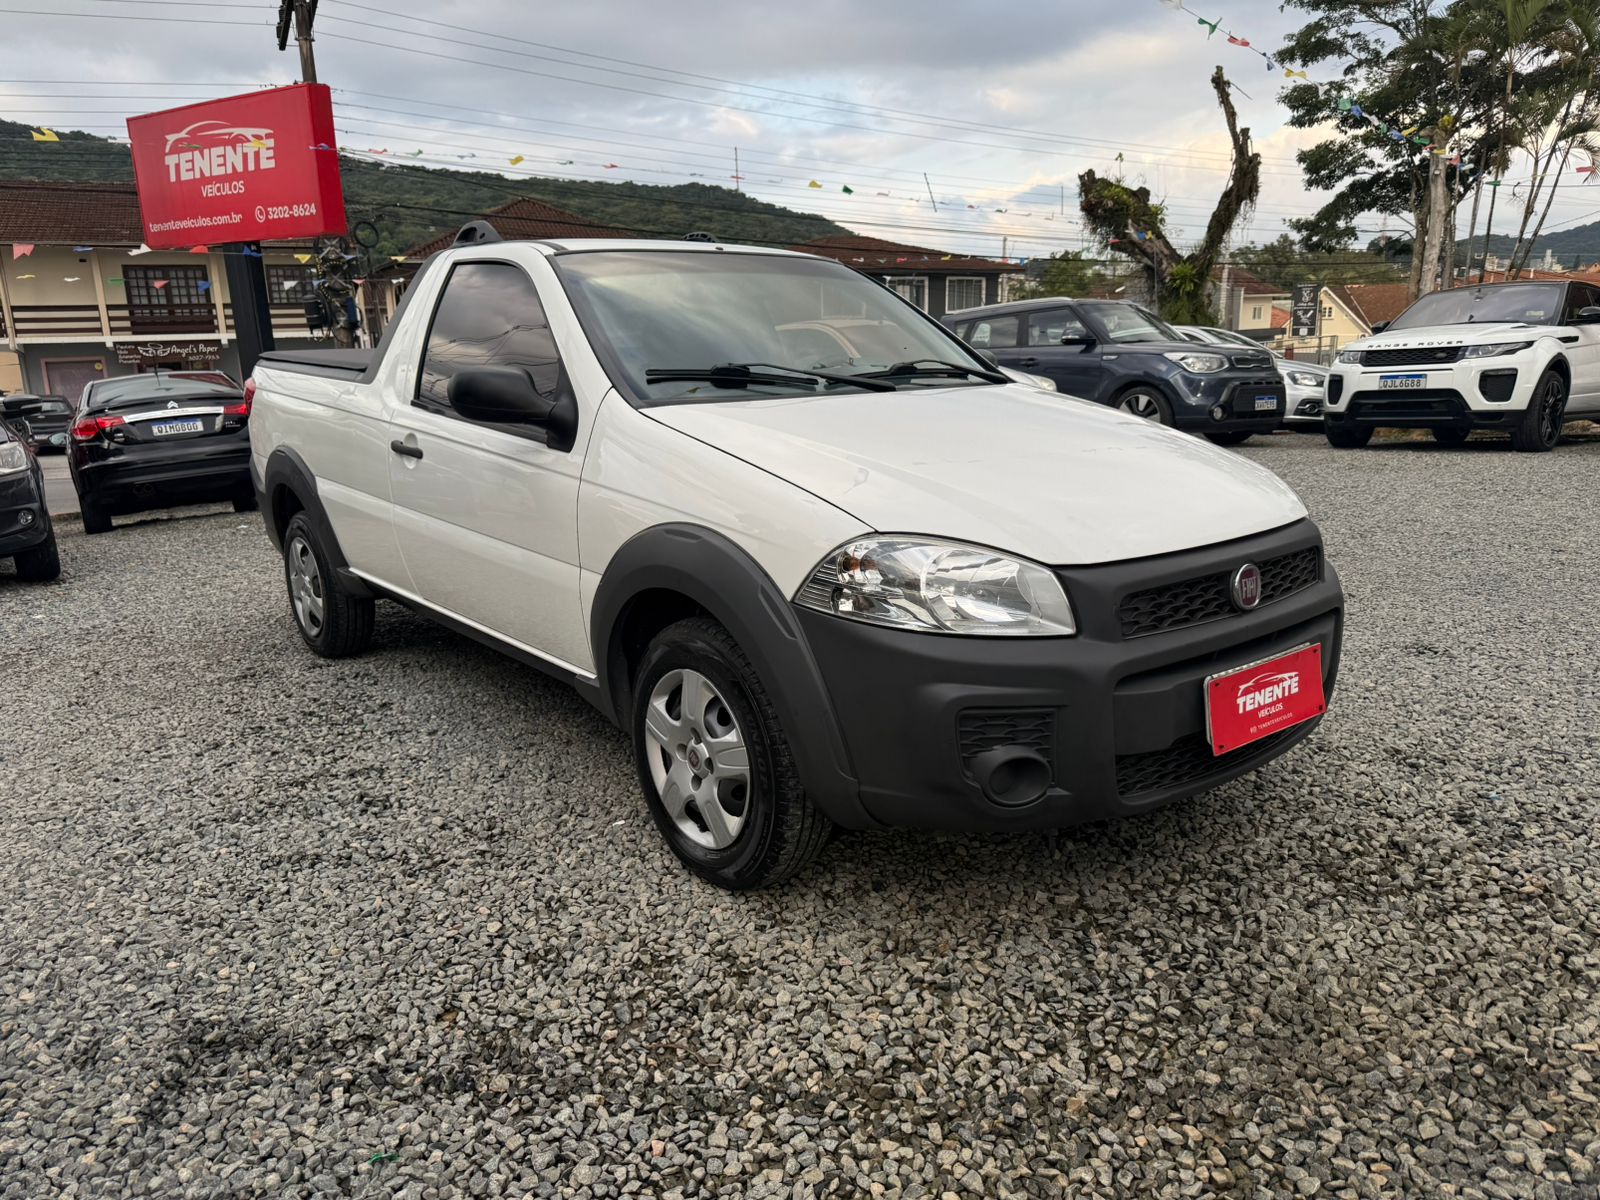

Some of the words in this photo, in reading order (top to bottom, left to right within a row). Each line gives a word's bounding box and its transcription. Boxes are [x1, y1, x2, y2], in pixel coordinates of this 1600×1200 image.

[165, 138, 276, 183] TENENTE
[201, 180, 245, 198] VEÍCULOS
[267, 203, 317, 219] 3202-8624
[1236, 675, 1299, 715] TENENTE
